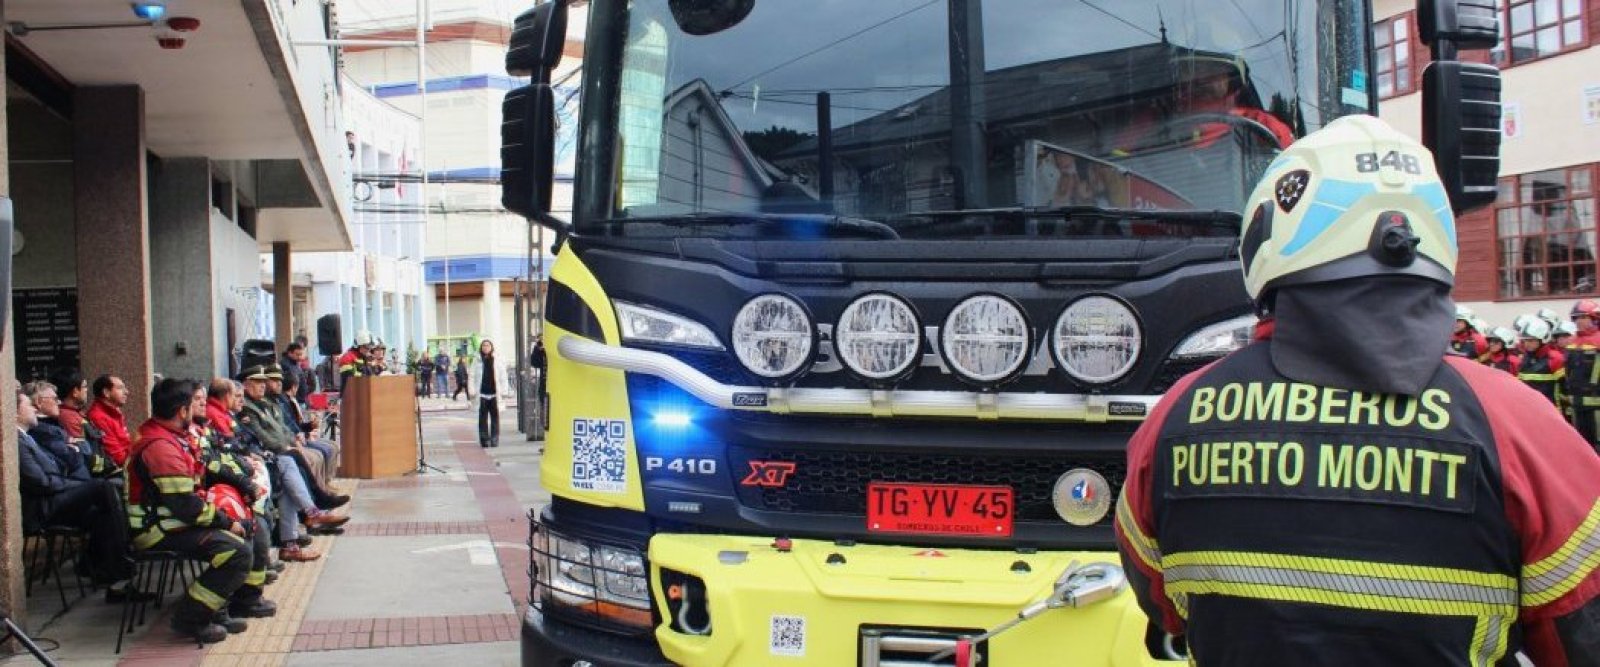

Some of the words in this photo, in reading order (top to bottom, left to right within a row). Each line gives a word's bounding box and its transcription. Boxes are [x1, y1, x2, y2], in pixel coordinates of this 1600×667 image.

[1355, 151, 1421, 175] 848
[1189, 382, 1451, 430] BOMBEROS
[646, 457, 663, 470] P
[667, 458, 716, 474] 410
[741, 460, 796, 486] XT
[1172, 441, 1305, 487] PUERTO
[1317, 443, 1467, 499] MONTT
